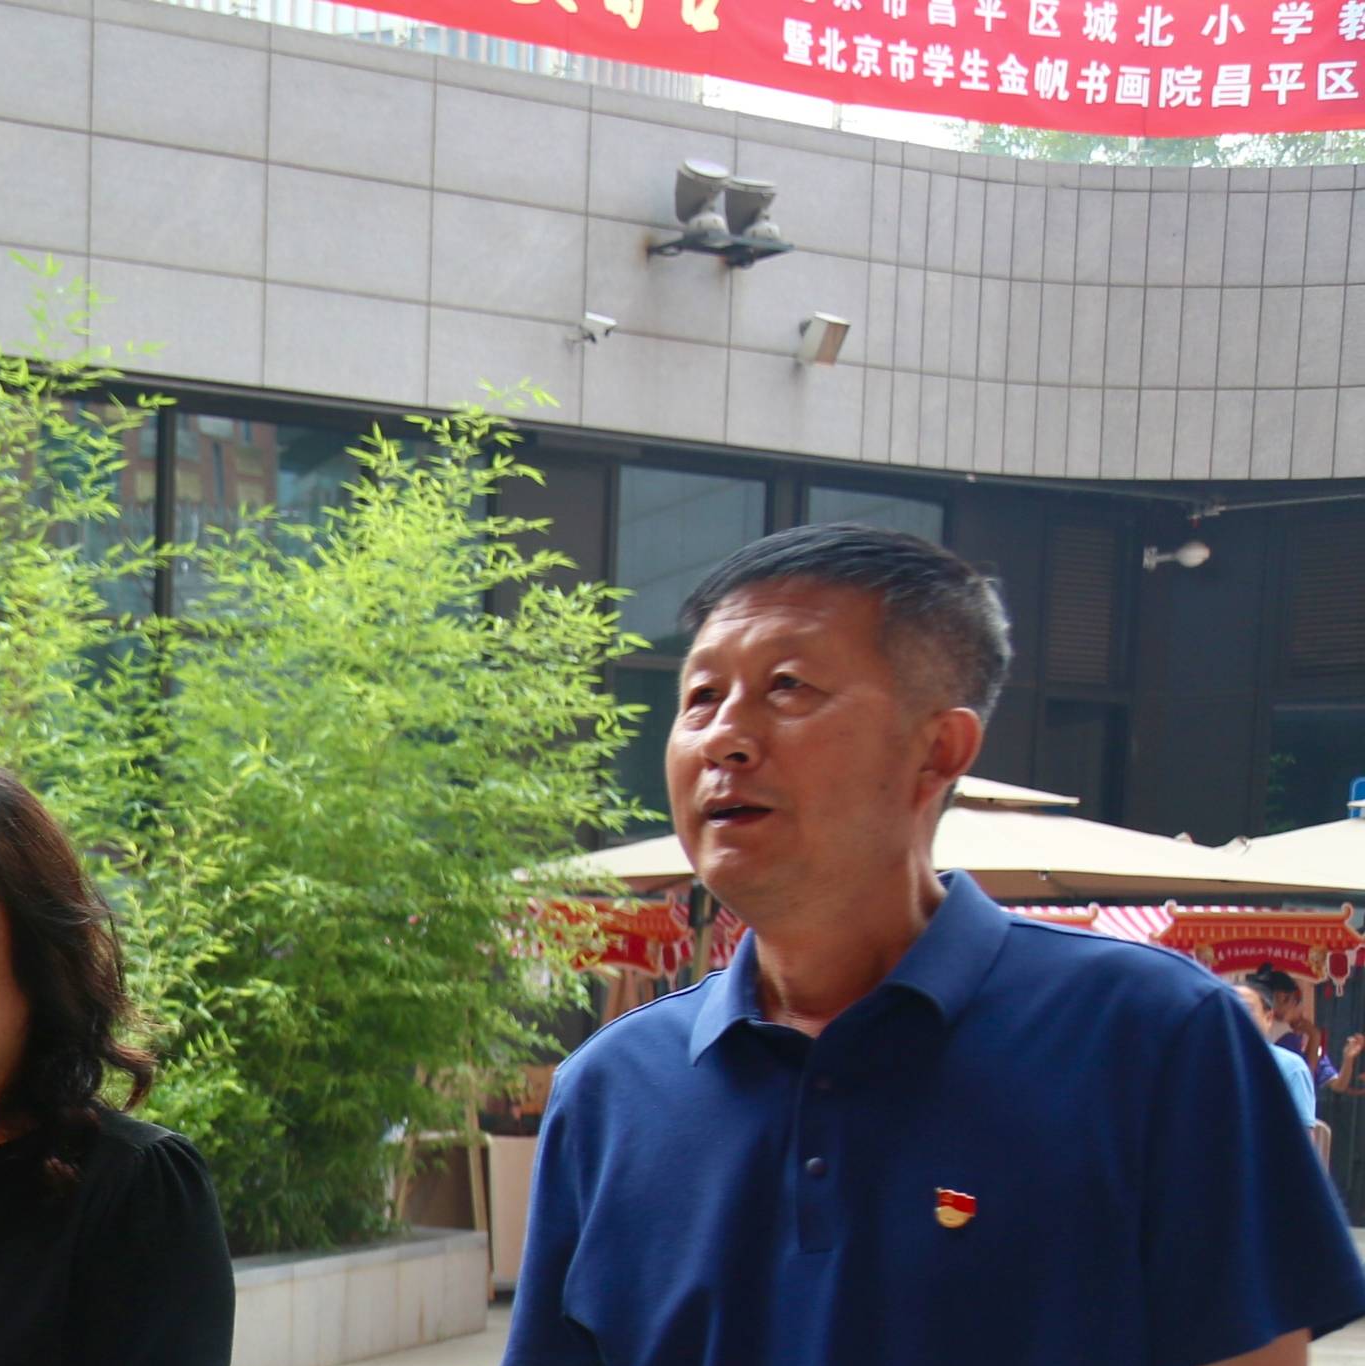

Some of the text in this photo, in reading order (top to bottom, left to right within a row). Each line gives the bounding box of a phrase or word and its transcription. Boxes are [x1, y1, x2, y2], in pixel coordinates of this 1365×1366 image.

[782, 17, 1360, 108] 暨北京市学生金帆书画院昌平区
